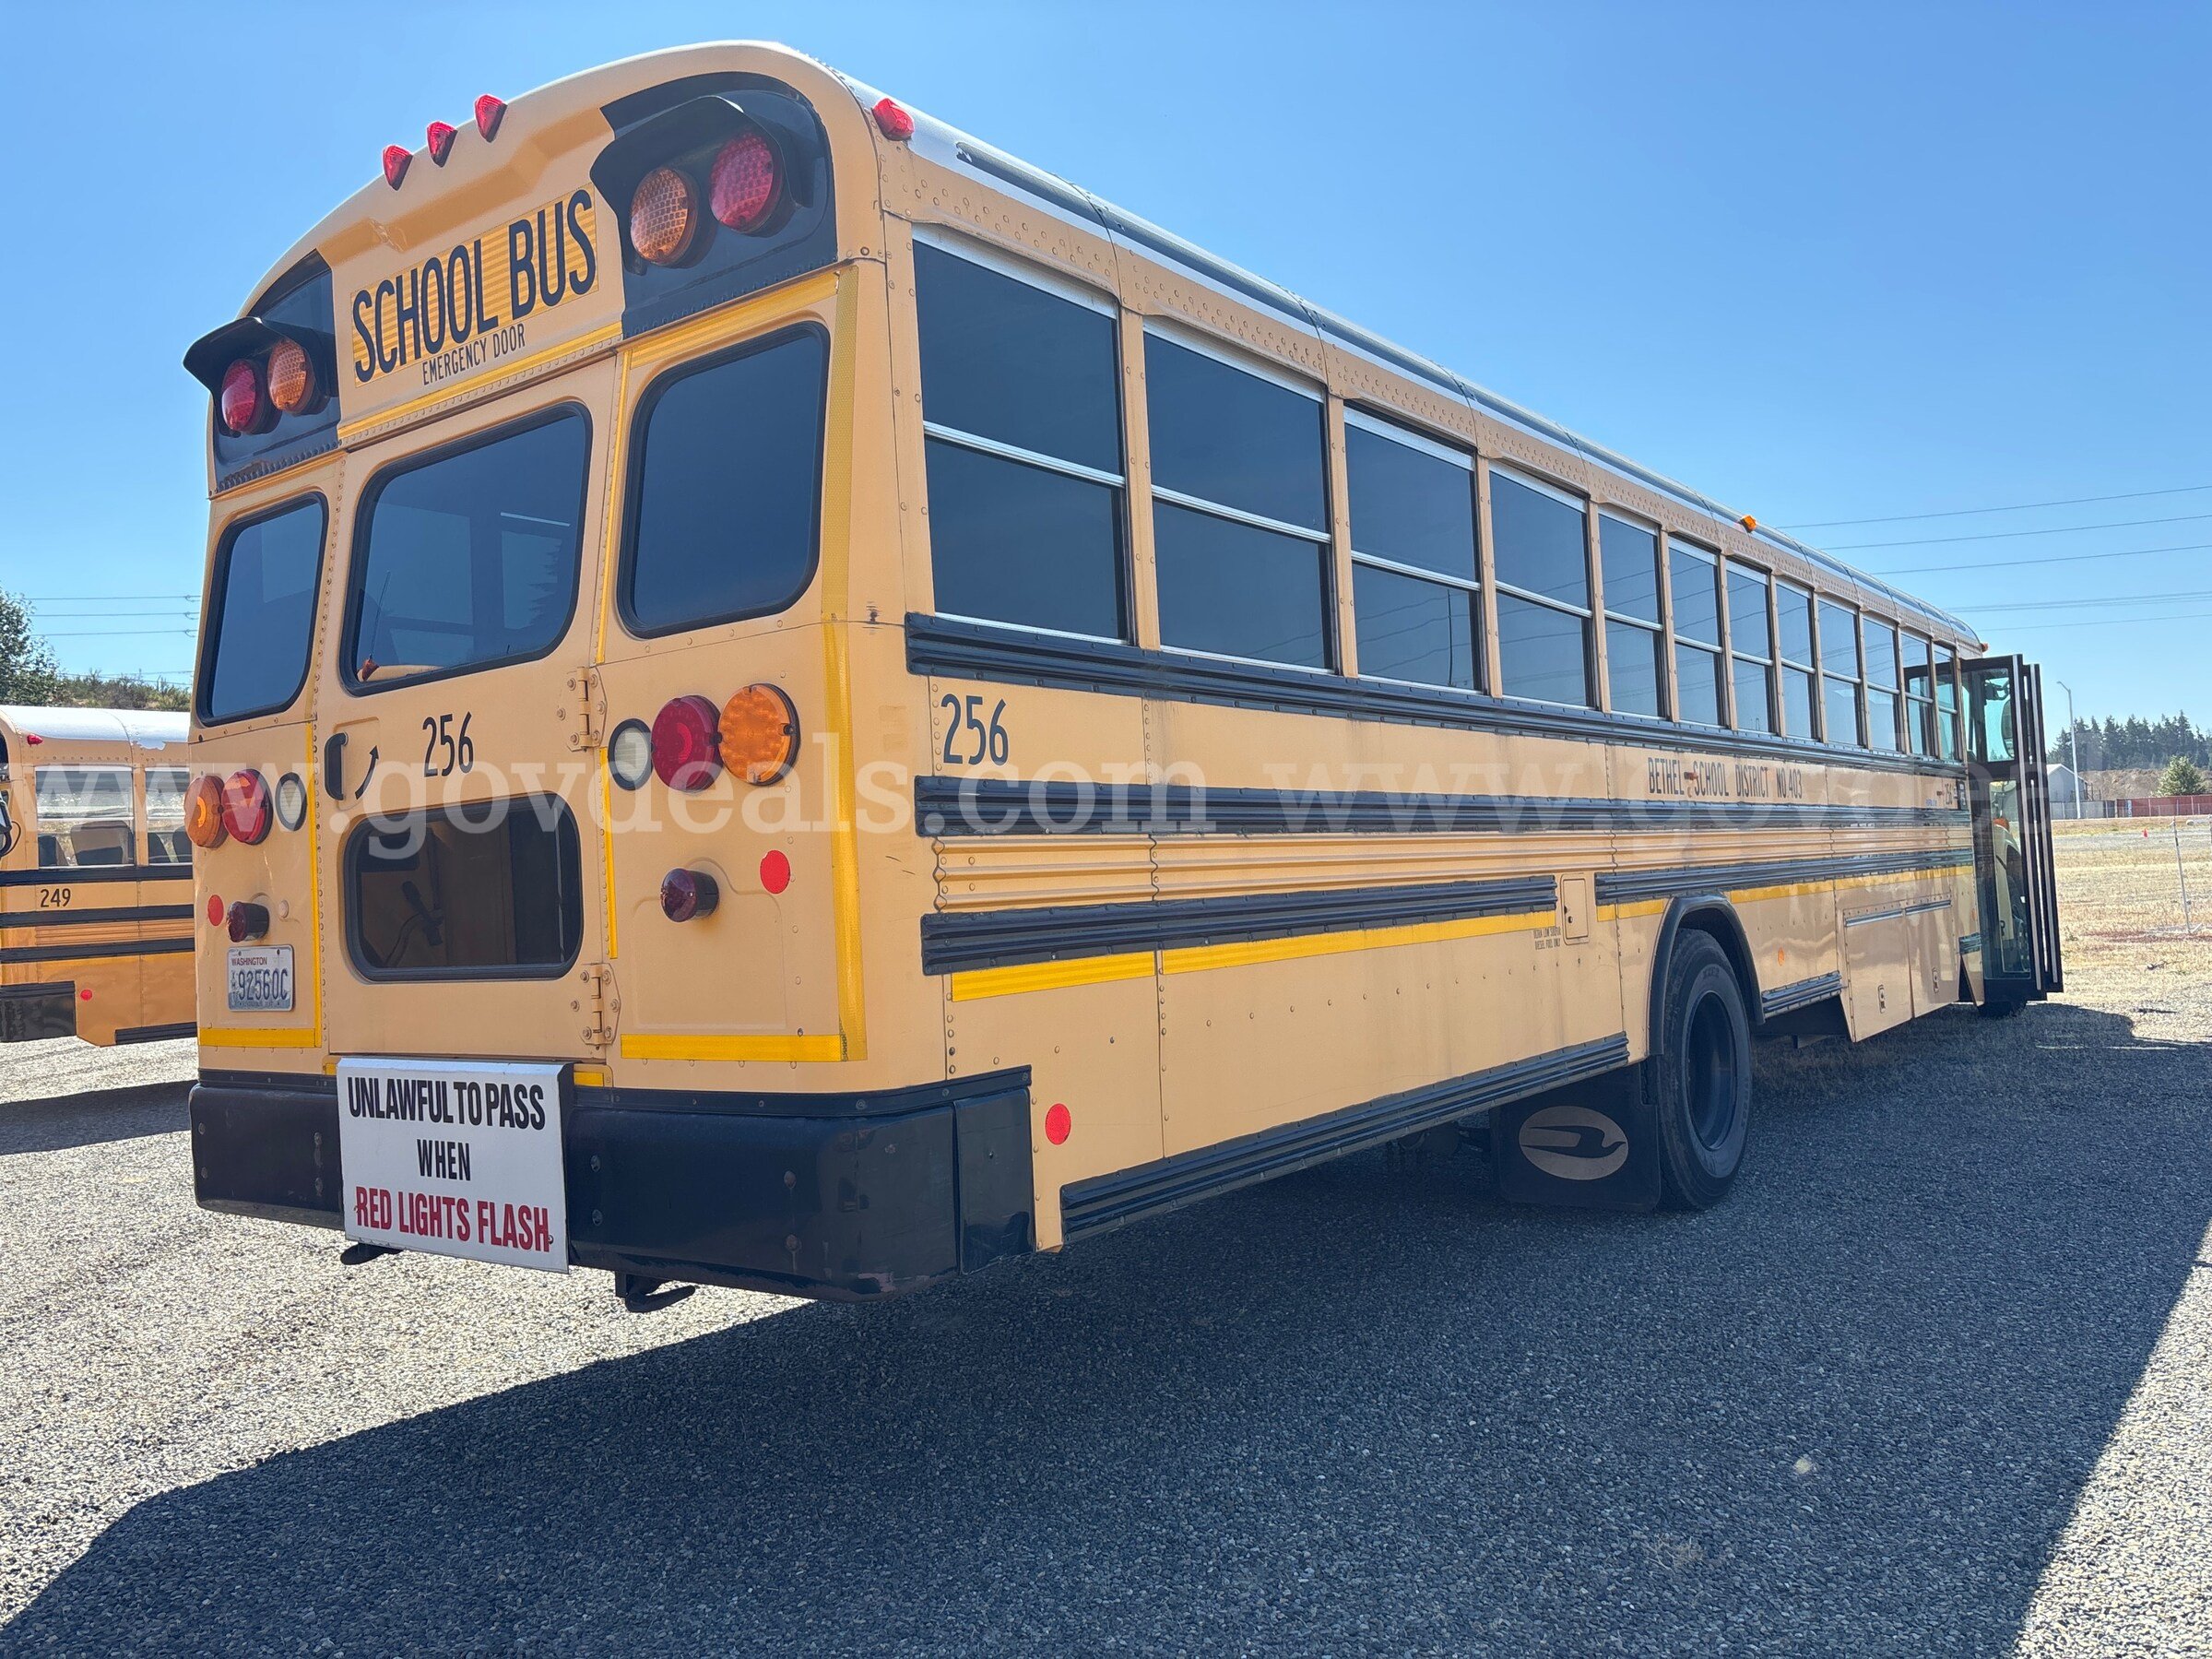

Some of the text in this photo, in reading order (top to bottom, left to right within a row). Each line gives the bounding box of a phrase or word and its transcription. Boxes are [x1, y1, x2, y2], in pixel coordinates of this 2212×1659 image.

[352, 189, 597, 383] SCHOOL BUS
[422, 323, 526, 385] EMERGENCY DOOR
[422, 711, 474, 777] 256
[940, 693, 1010, 766] 256
[1648, 757, 1685, 795] BETHEL
[1693, 760, 1729, 797] SCHOOL
[1735, 764, 1768, 798] DISTRICT
[40, 888, 71, 907] 249
[231, 957, 268, 966] WASHINGTON
[238, 968, 288, 1001] 92560C
[347, 1077, 546, 1131] UNLAWFUL TO PASS
[417, 1139, 471, 1181] WHEN
[355, 1186, 550, 1252] RED LIGHTS FLASH
